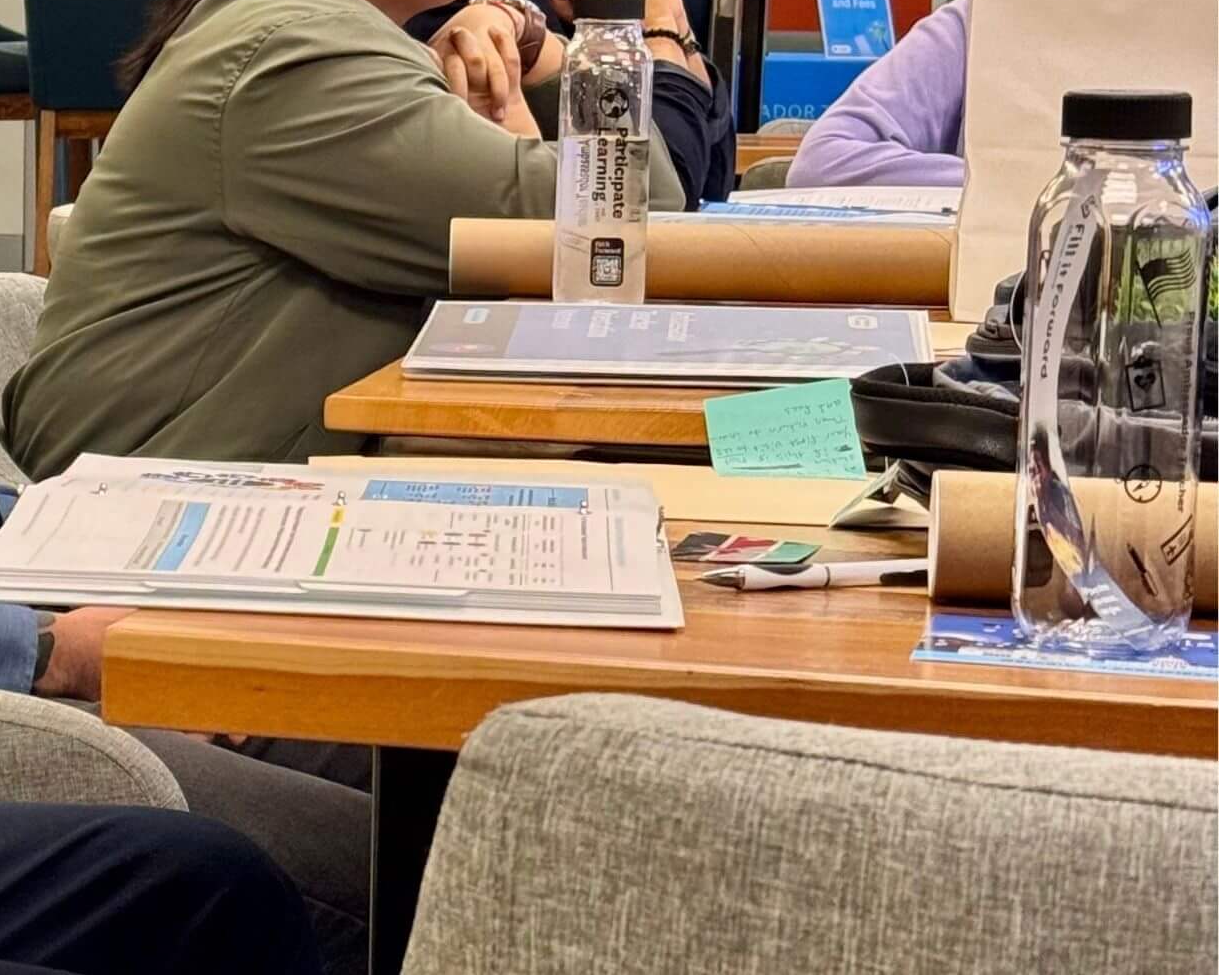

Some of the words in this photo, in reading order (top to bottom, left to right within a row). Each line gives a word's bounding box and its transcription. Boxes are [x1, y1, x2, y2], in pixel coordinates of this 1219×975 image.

[611, 127, 629, 219] Participate
[1065, 224, 1085, 256] Fill
[1040, 283, 1063, 379] Forward
